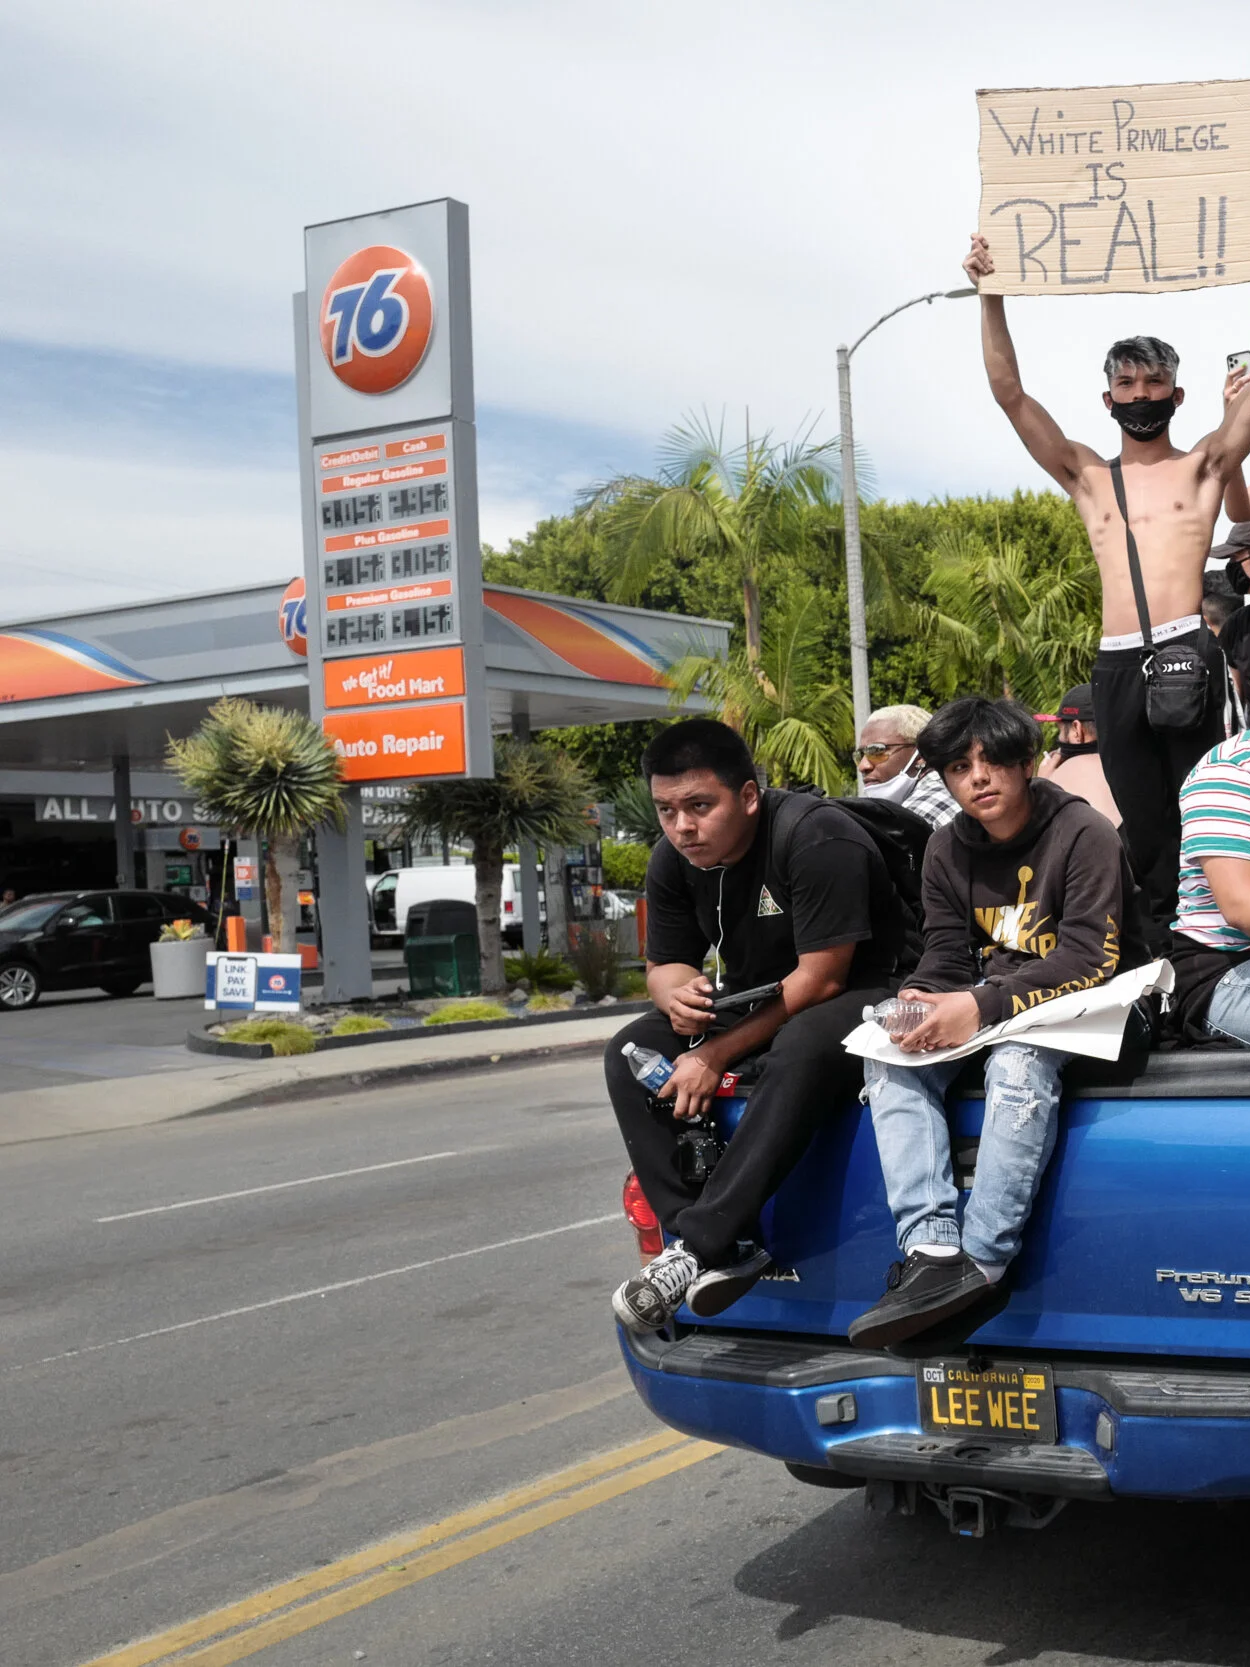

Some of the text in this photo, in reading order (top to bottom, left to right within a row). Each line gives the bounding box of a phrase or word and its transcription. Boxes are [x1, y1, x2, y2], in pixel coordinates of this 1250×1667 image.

[1085, 161, 1127, 201] IS
[326, 268, 409, 366] 76
[402, 440, 428, 453] Cash
[342, 465, 424, 487] Regular Gasoline
[353, 528, 419, 546] Plus Gasoline
[345, 586, 432, 607] Premium Gasoline
[368, 676, 445, 698] Food Mart
[334, 730, 445, 758] Auto Repair
[42, 798, 98, 820] ALL
[1179, 1287, 1222, 1303] V6
[926, 1370, 942, 1381] OCT
[931, 1386, 1040, 1430] LEE WEE
